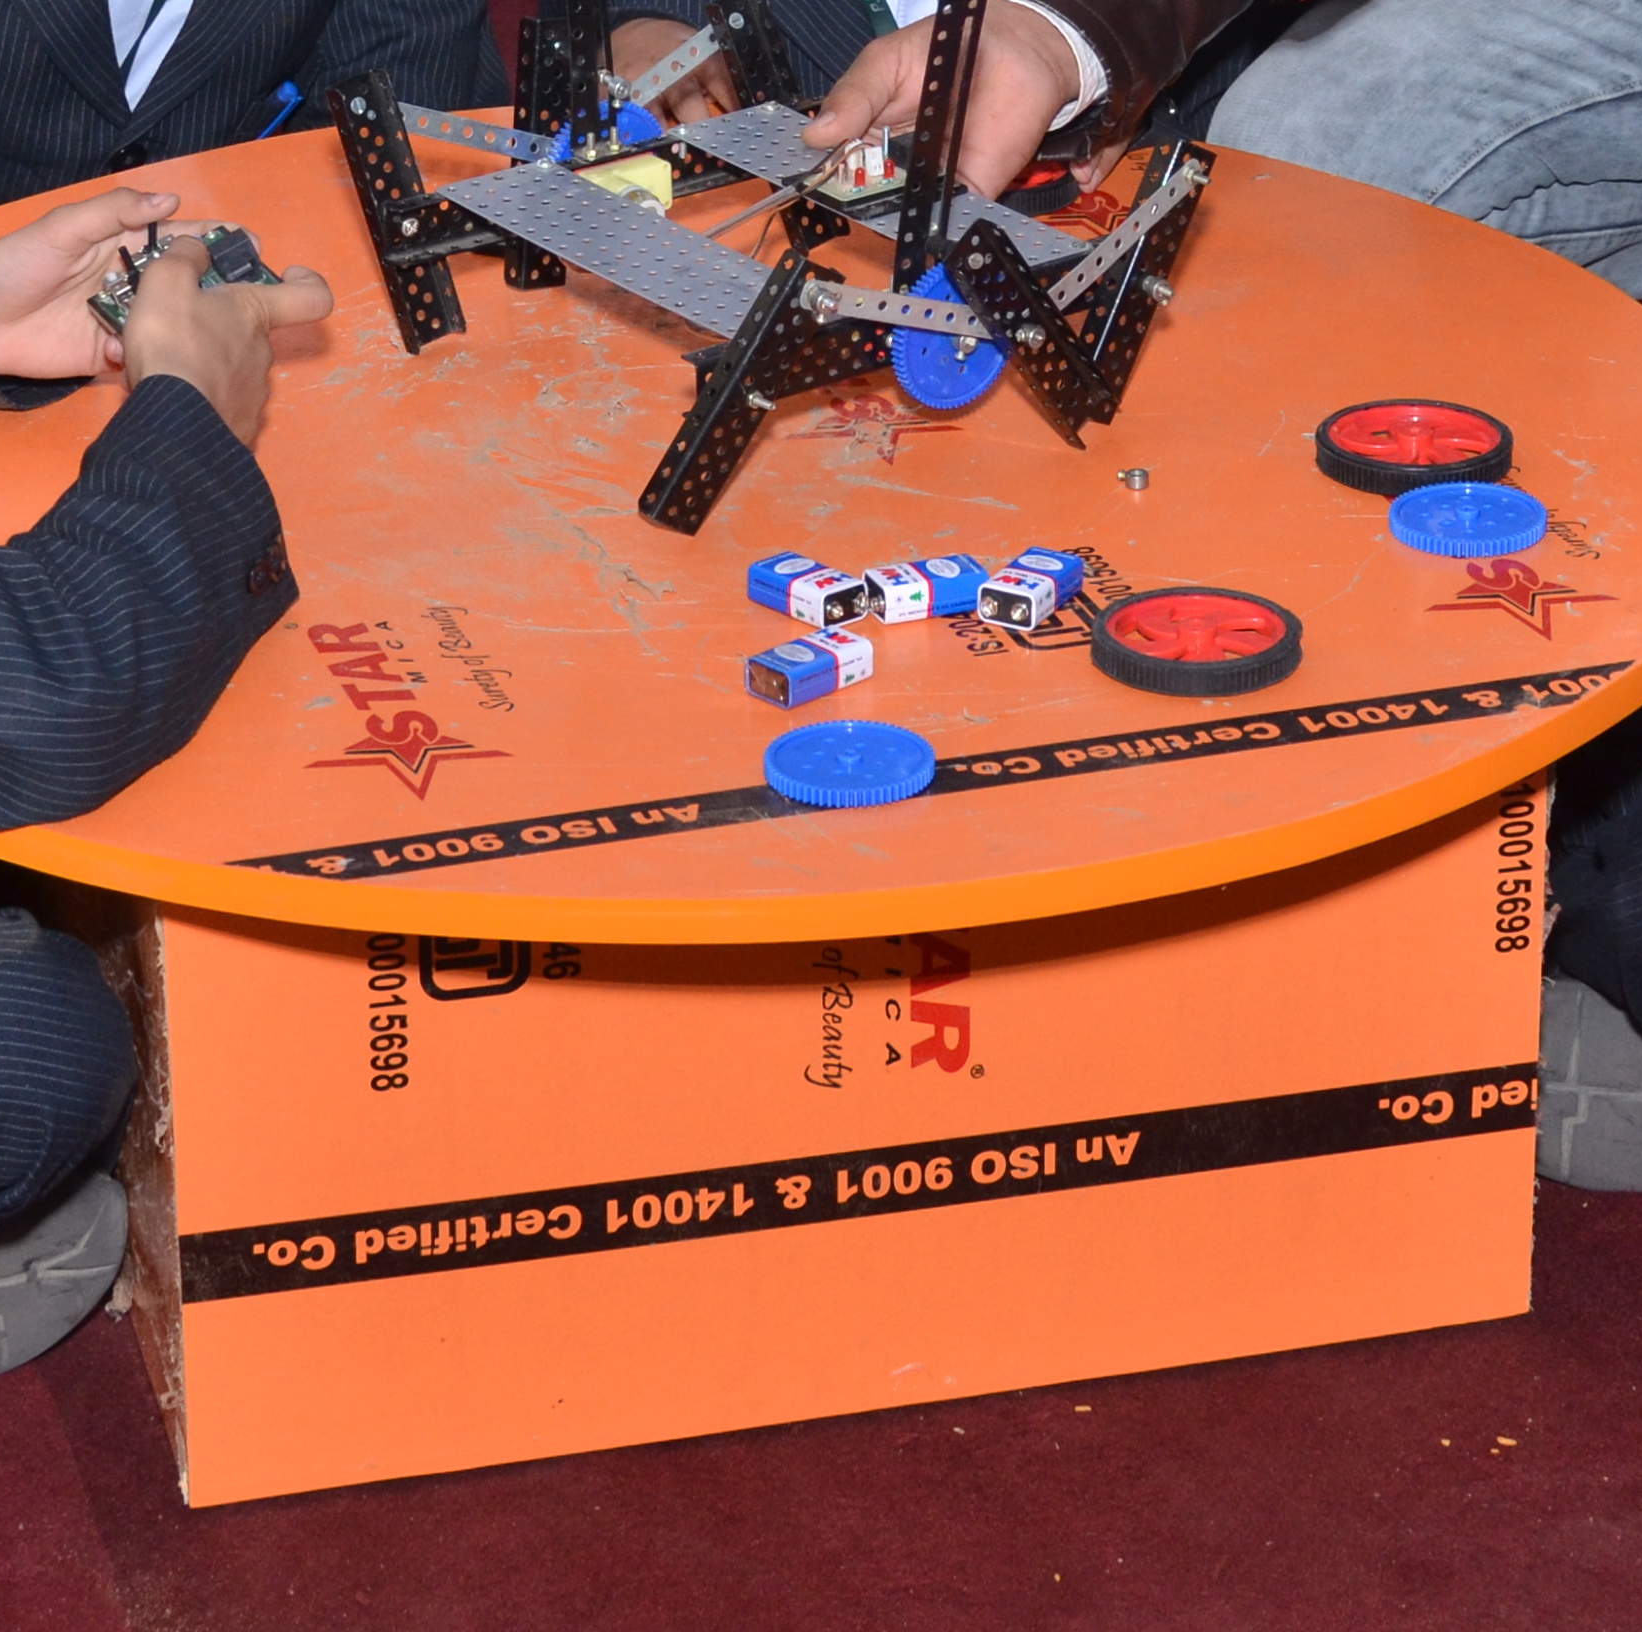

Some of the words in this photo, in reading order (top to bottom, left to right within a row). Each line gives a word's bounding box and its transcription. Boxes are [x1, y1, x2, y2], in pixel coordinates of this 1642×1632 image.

[420, 606, 471, 653] Beauty
[373, 620, 429, 685] MICA
[306, 621, 441, 747] STAR
[463, 668, 516, 712] Surety
[1462, 689, 1503, 709] &
[1520, 670, 1627, 701] 001
[1296, 697, 1450, 734] 14001
[1054, 721, 1283, 770] Certified
[953, 754, 1042, 777] Co.
[519, 815, 619, 845] ISO
[630, 802, 701, 827] An
[371, 832, 505, 868] 9001
[909, 930, 971, 1074] AR
[804, 981, 854, 1090] Beauty
[1378, 1090, 1455, 1125] Co.
[969, 1143, 1057, 1185] ISO
[1075, 1130, 1142, 1167] An
[774, 1174, 812, 1210] &
[835, 1156, 955, 1205] 9001
[606, 1182, 755, 1235] 14001
[252, 1235, 337, 1271] Co.
[354, 1204, 584, 1265] Certified
